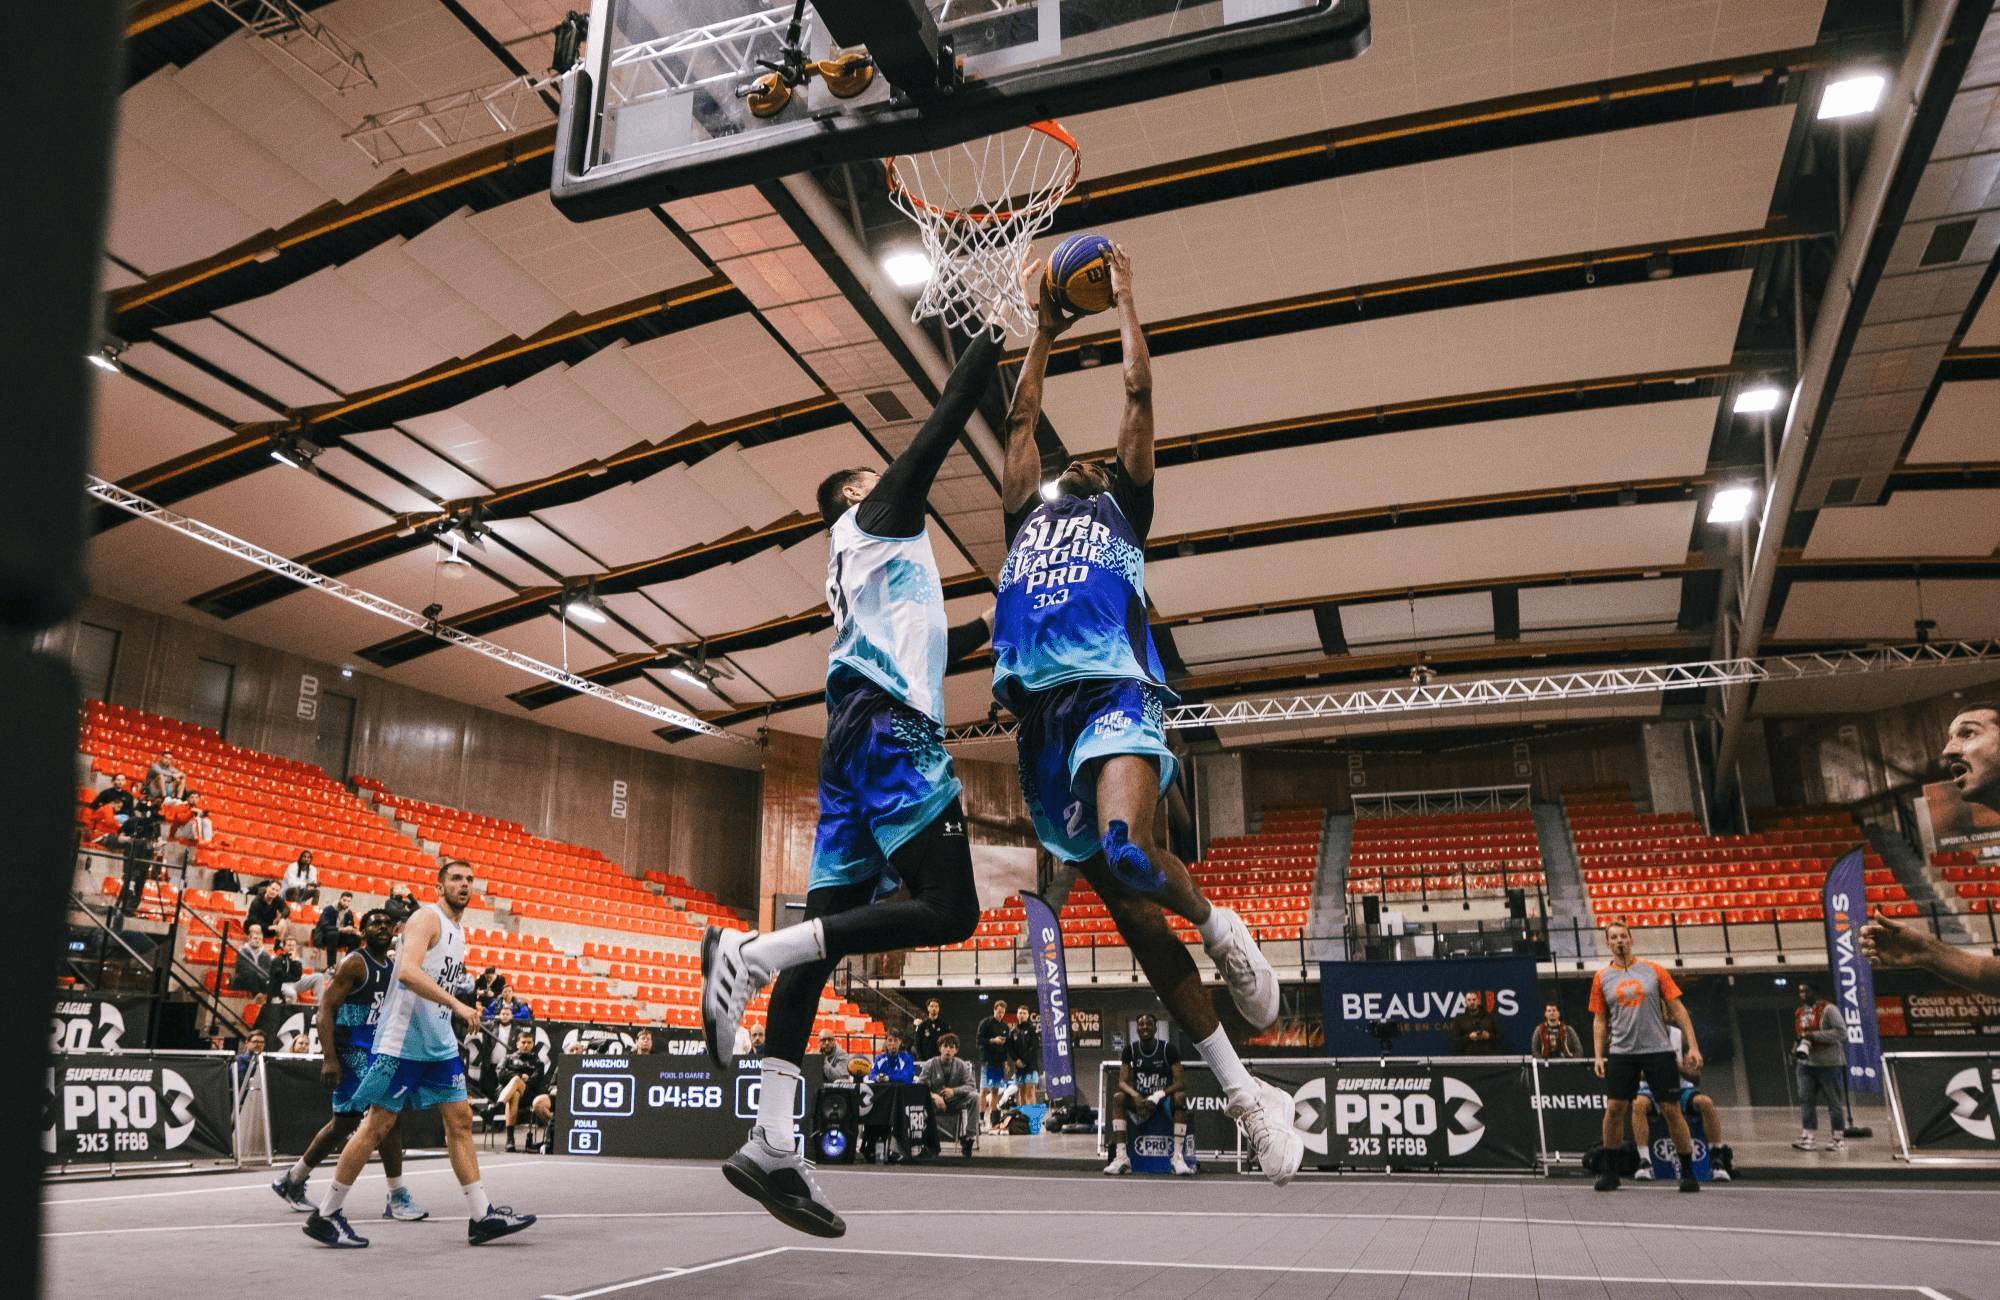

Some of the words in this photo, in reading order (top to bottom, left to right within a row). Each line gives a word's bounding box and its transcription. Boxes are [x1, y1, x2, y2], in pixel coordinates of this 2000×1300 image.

[1019, 514, 1111, 551] SUPER
[1013, 541, 1102, 583] LEAGUE
[1026, 565, 1089, 595] PRO
[1063, 800, 1087, 839] 2
[1832, 893, 1864, 1044] BEAUVAIS
[65, 1068, 153, 1082] SUPERLEAGUE
[582, 1059, 628, 1069] HANGZHOU
[738, 1060, 763, 1069] SAIN
[581, 1081, 624, 1108] 09
[648, 1085, 722, 1108] 04:58
[1336, 1078, 1432, 1091] SUPERLEAGUE
[63, 1085, 157, 1131] PRO
[1335, 1093, 1438, 1135] PRO
[76, 1133, 109, 1153] 3X3
[114, 1131, 149, 1151] FFBB
[578, 1132, 591, 1150] 6
[1348, 1137, 1381, 1155] 3X3
[1387, 1137, 1428, 1156] FFBB
